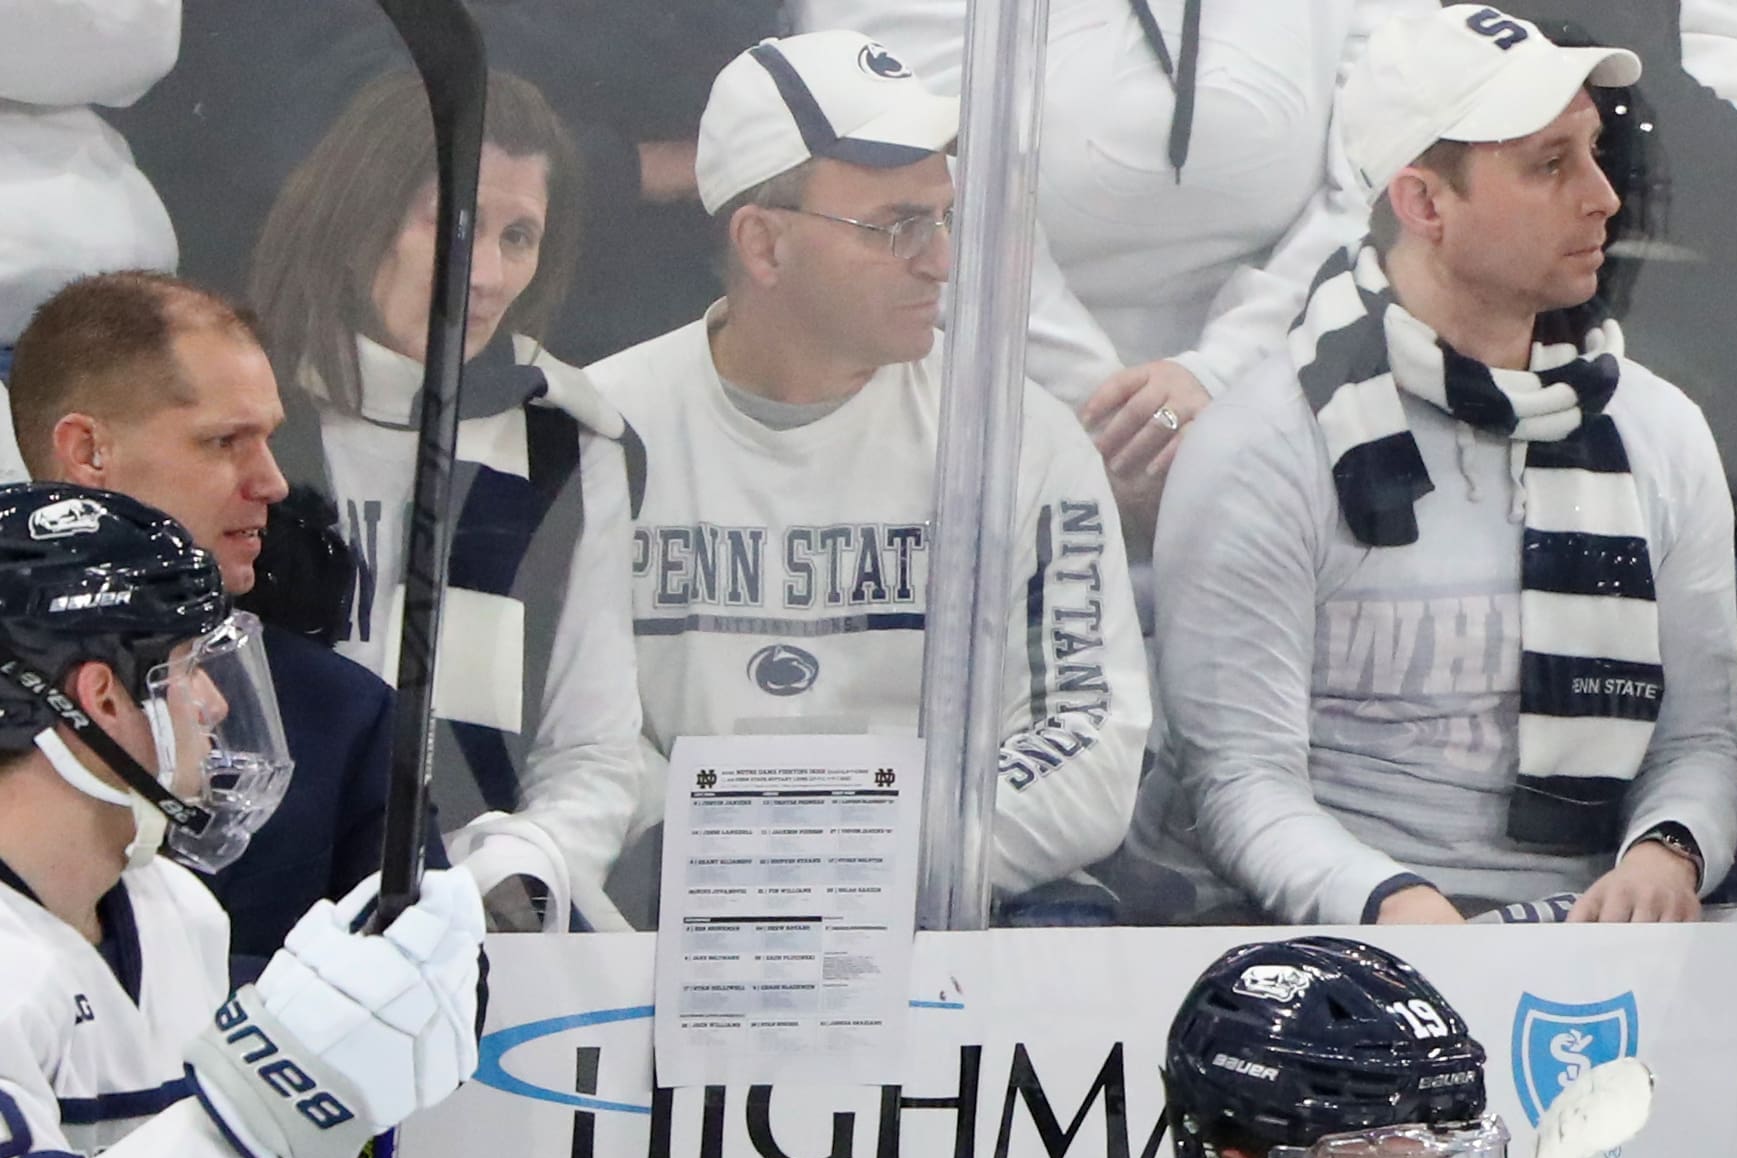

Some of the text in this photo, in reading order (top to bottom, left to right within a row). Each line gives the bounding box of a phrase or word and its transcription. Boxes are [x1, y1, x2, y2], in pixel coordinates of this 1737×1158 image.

[783, 522, 930, 608] STAT
[1049, 499, 1112, 730] NITTANY
[1603, 677, 1658, 700] STATE
[1393, 998, 1449, 1040] 19
